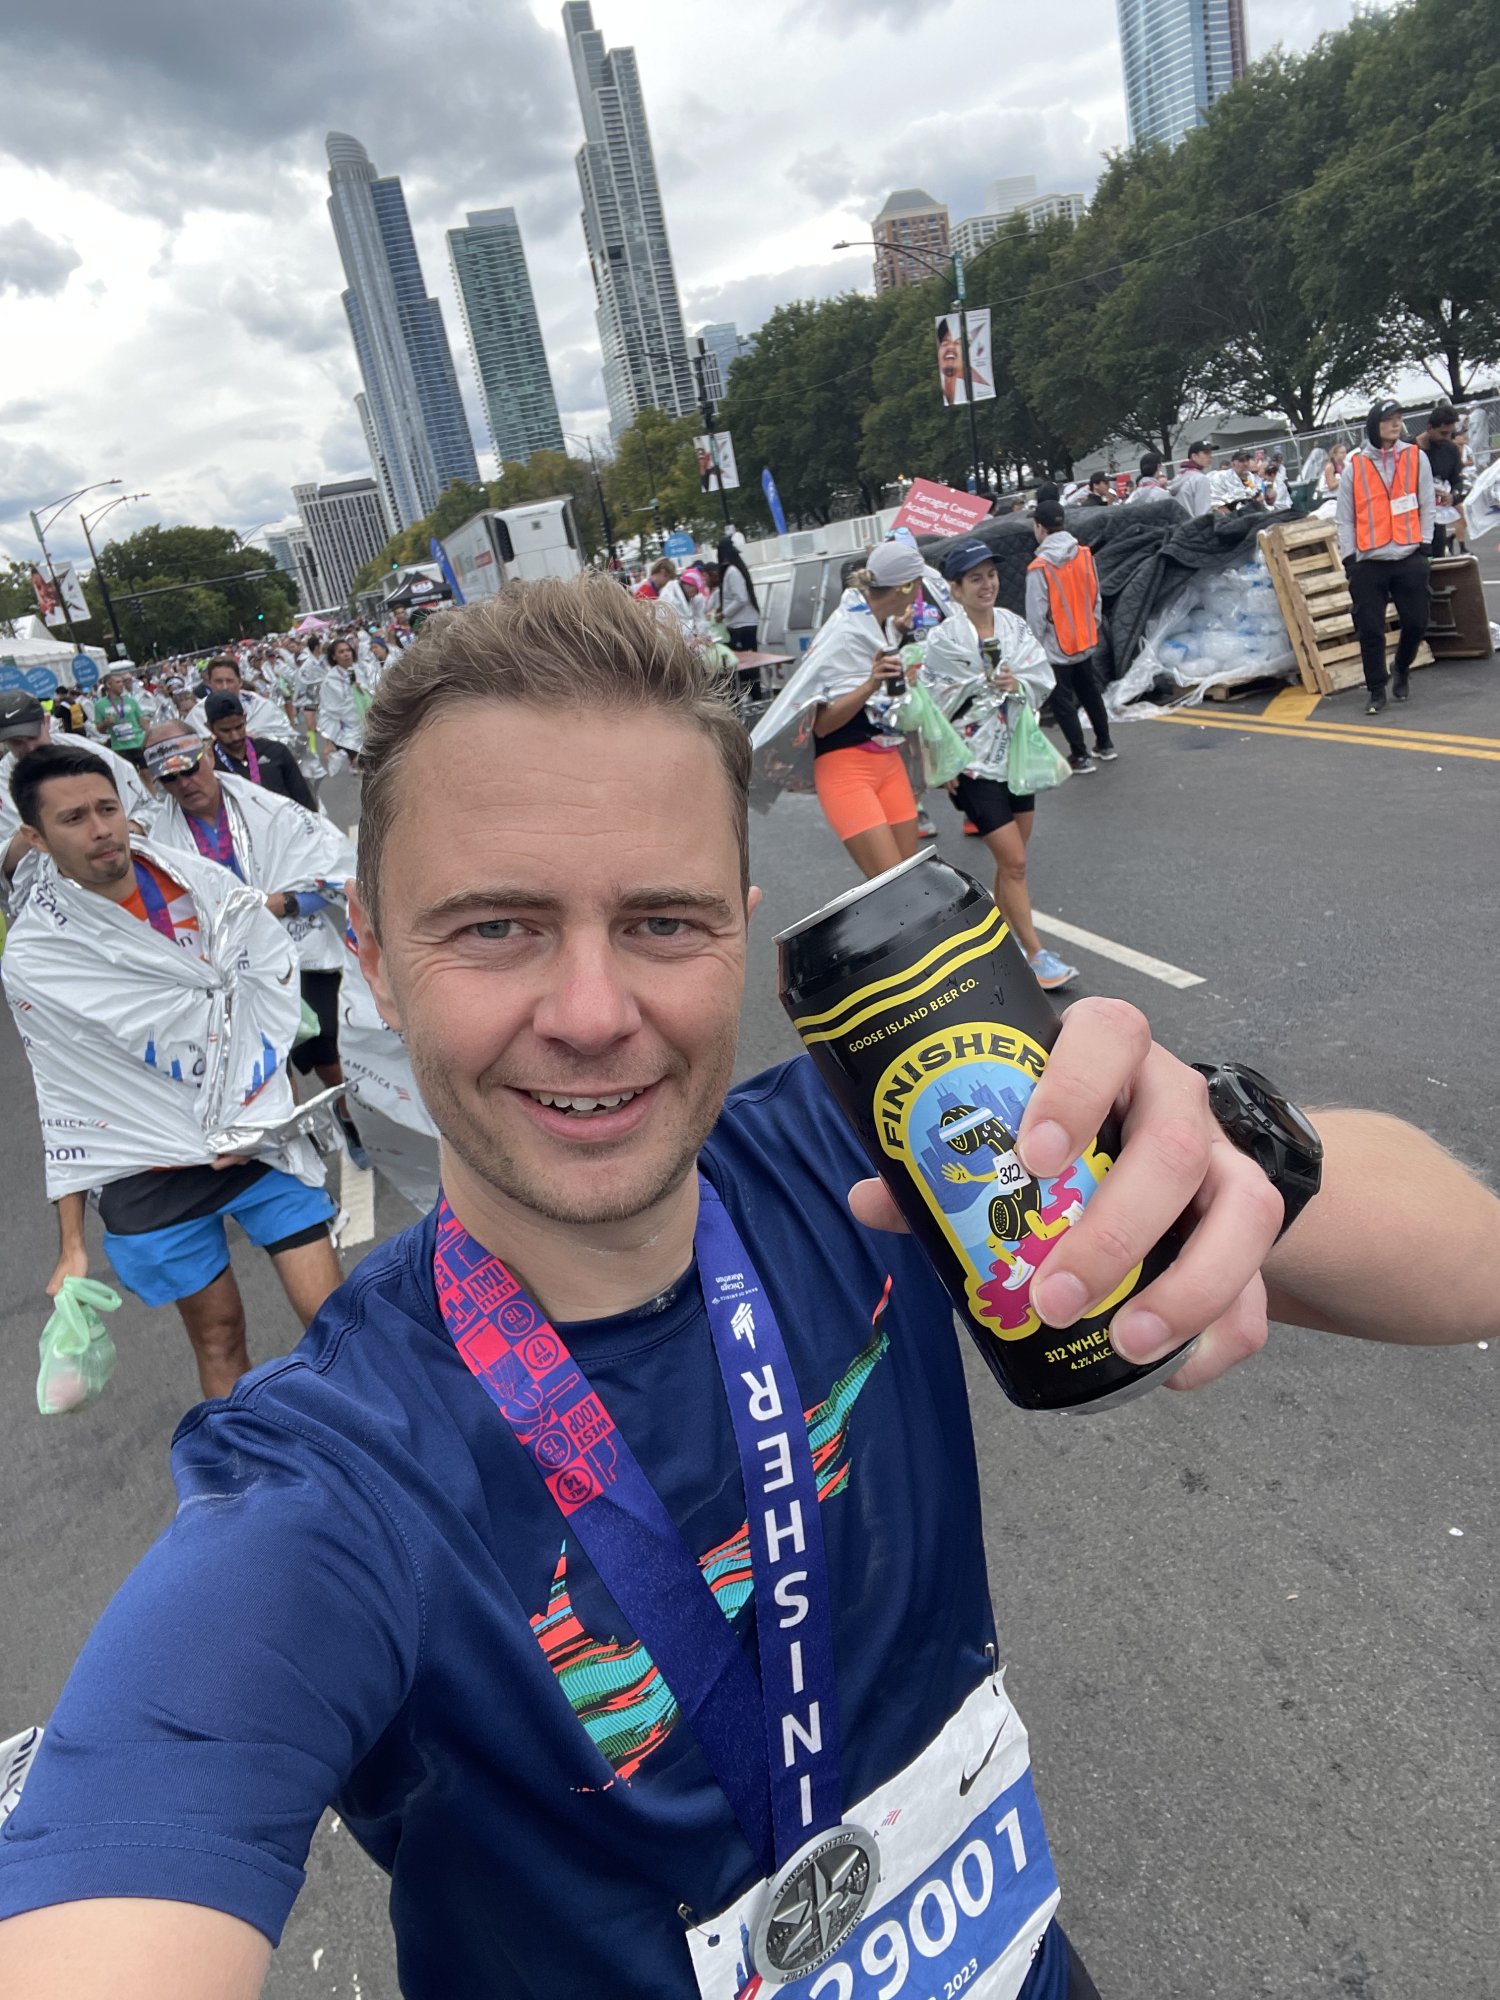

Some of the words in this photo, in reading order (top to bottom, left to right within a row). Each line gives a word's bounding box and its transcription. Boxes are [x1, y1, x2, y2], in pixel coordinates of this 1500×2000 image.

[848, 1029, 886, 1053] GOOSE
[885, 1007, 929, 1036] ISLAND
[929, 988, 960, 1012] BEER
[960, 978, 980, 993] CO.
[343, 1060, 391, 1090] AMERICA
[882, 1033, 1046, 1150] FINISHER
[999, 1163, 1025, 1186] 312
[715, 1272, 744, 1283] Marathon
[720, 1281, 745, 1291] Chicago
[480, 1281, 517, 1310] LITTLE
[504, 1306, 523, 1324] 18
[532, 1339, 548, 1358] 17
[536, 1350, 555, 1366] MILE
[1044, 1347, 1069, 1363] 312
[1066, 1327, 1110, 1355] WHEA
[1070, 1356, 1092, 1370] 4.2%
[568, 1399, 600, 1434] LOOP
[542, 1437, 560, 1456] 15
[577, 1417, 611, 1450] WEST
[563, 1473, 583, 1490] 14
[569, 1484, 590, 1499] MILE
[741, 1364, 824, 1828] INISHER
[776, 1868, 802, 1900] BANK
[801, 1853, 818, 1870] OF
[817, 1832, 856, 1856] AMERICA
[808, 1807, 1027, 2000] 29001
[943, 1957, 979, 2000] 2023
